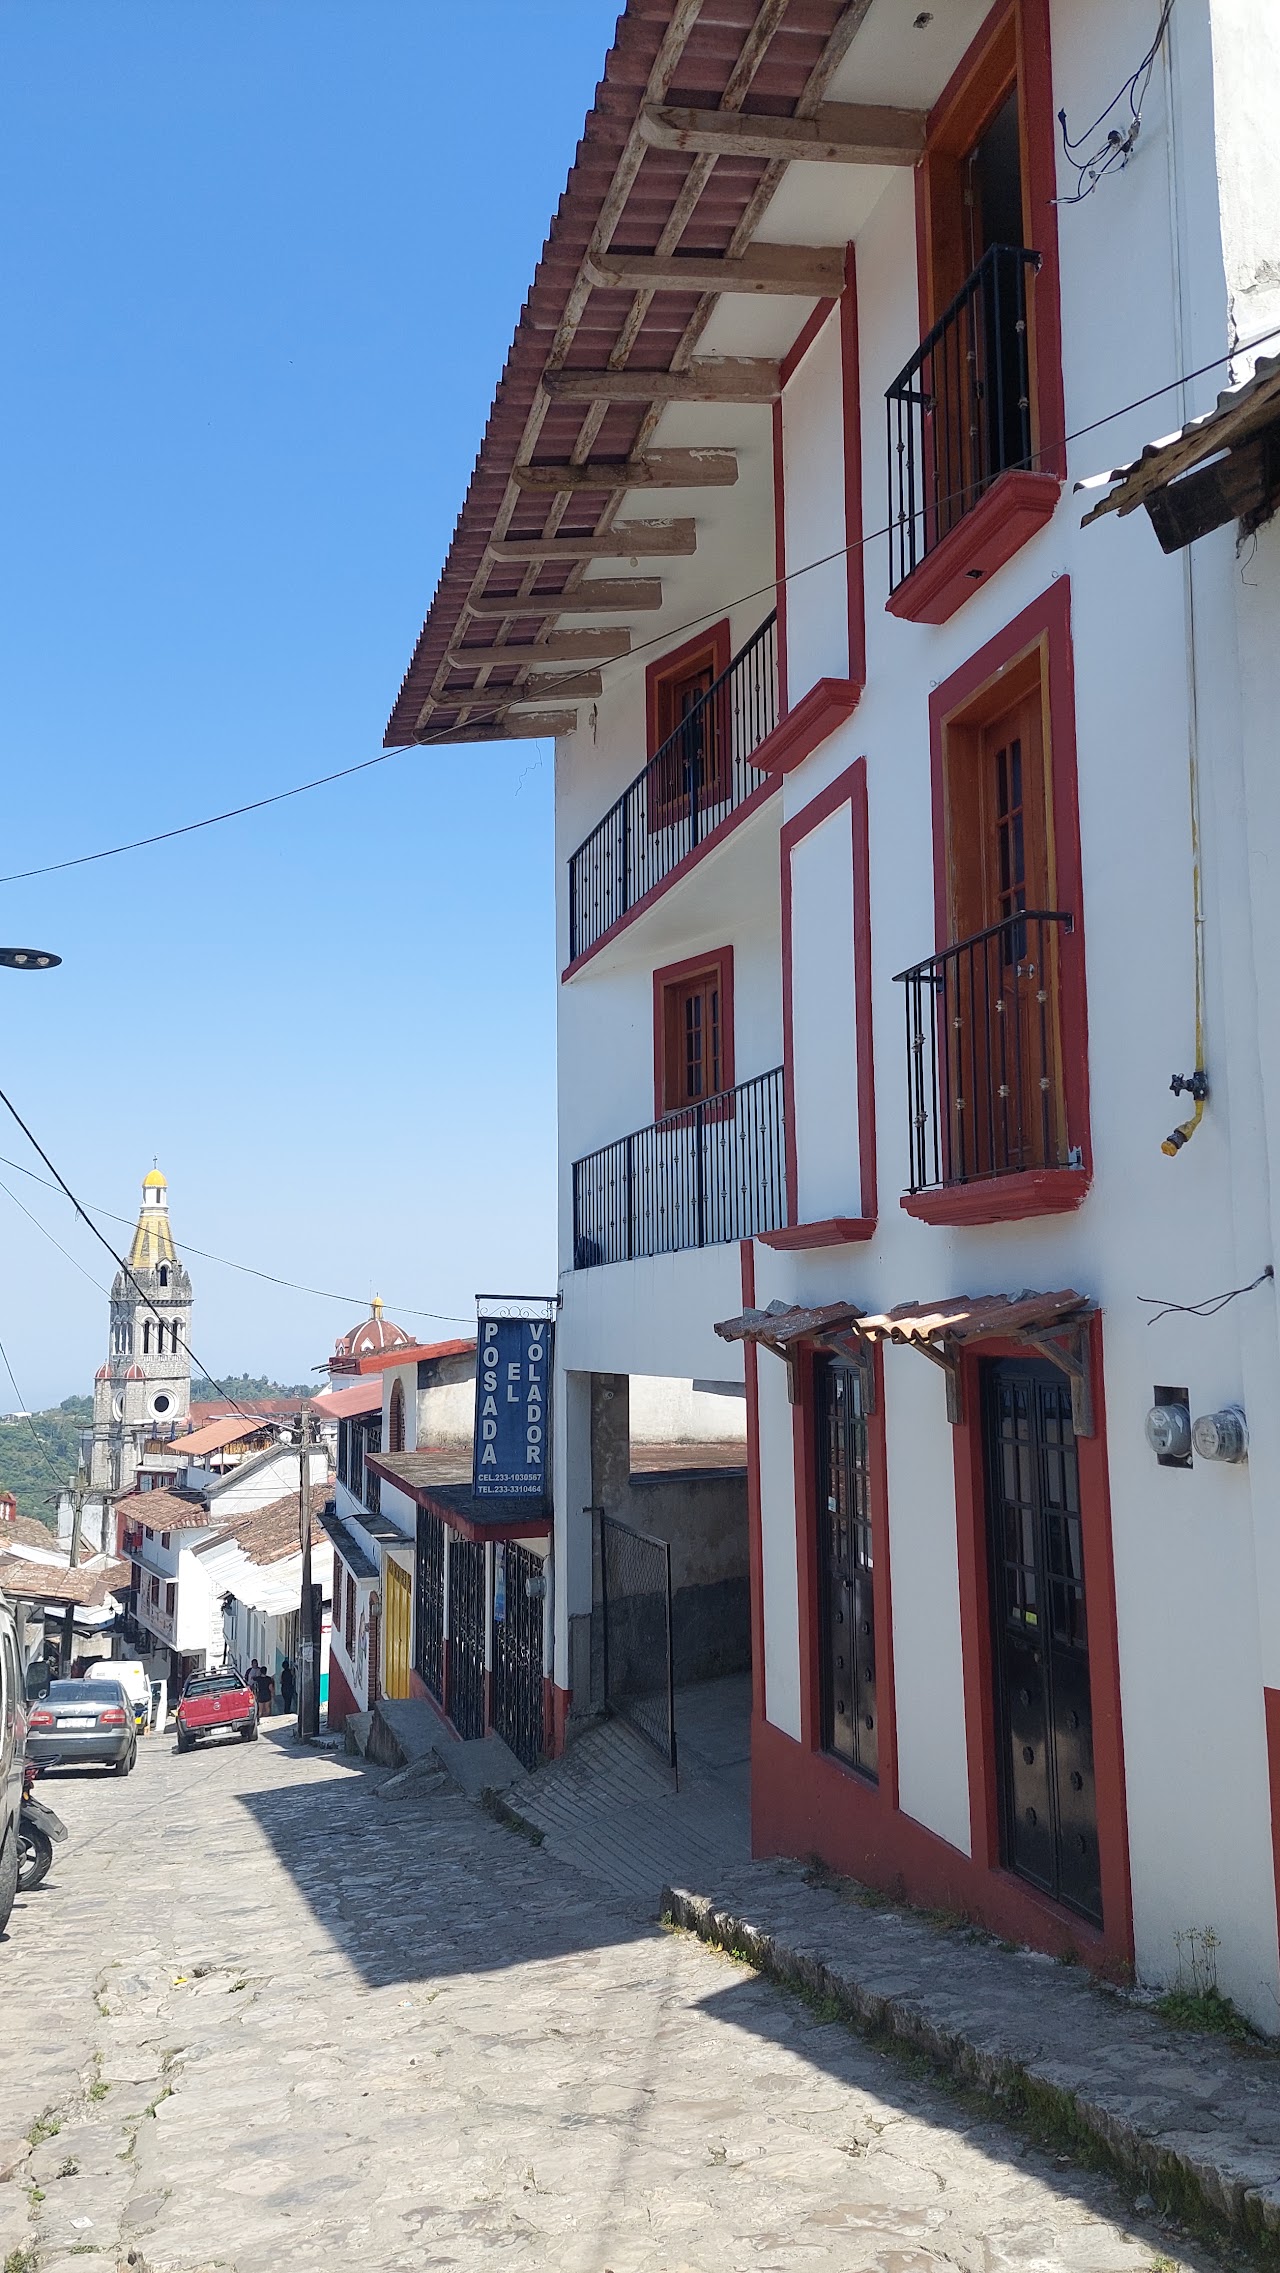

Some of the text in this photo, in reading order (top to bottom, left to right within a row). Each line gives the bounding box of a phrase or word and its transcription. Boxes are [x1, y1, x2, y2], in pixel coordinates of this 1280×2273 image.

[481, 1322, 499, 1465] POSADA
[507, 1363, 521, 1402] EL
[526, 1323, 544, 1464] VOLADOR
